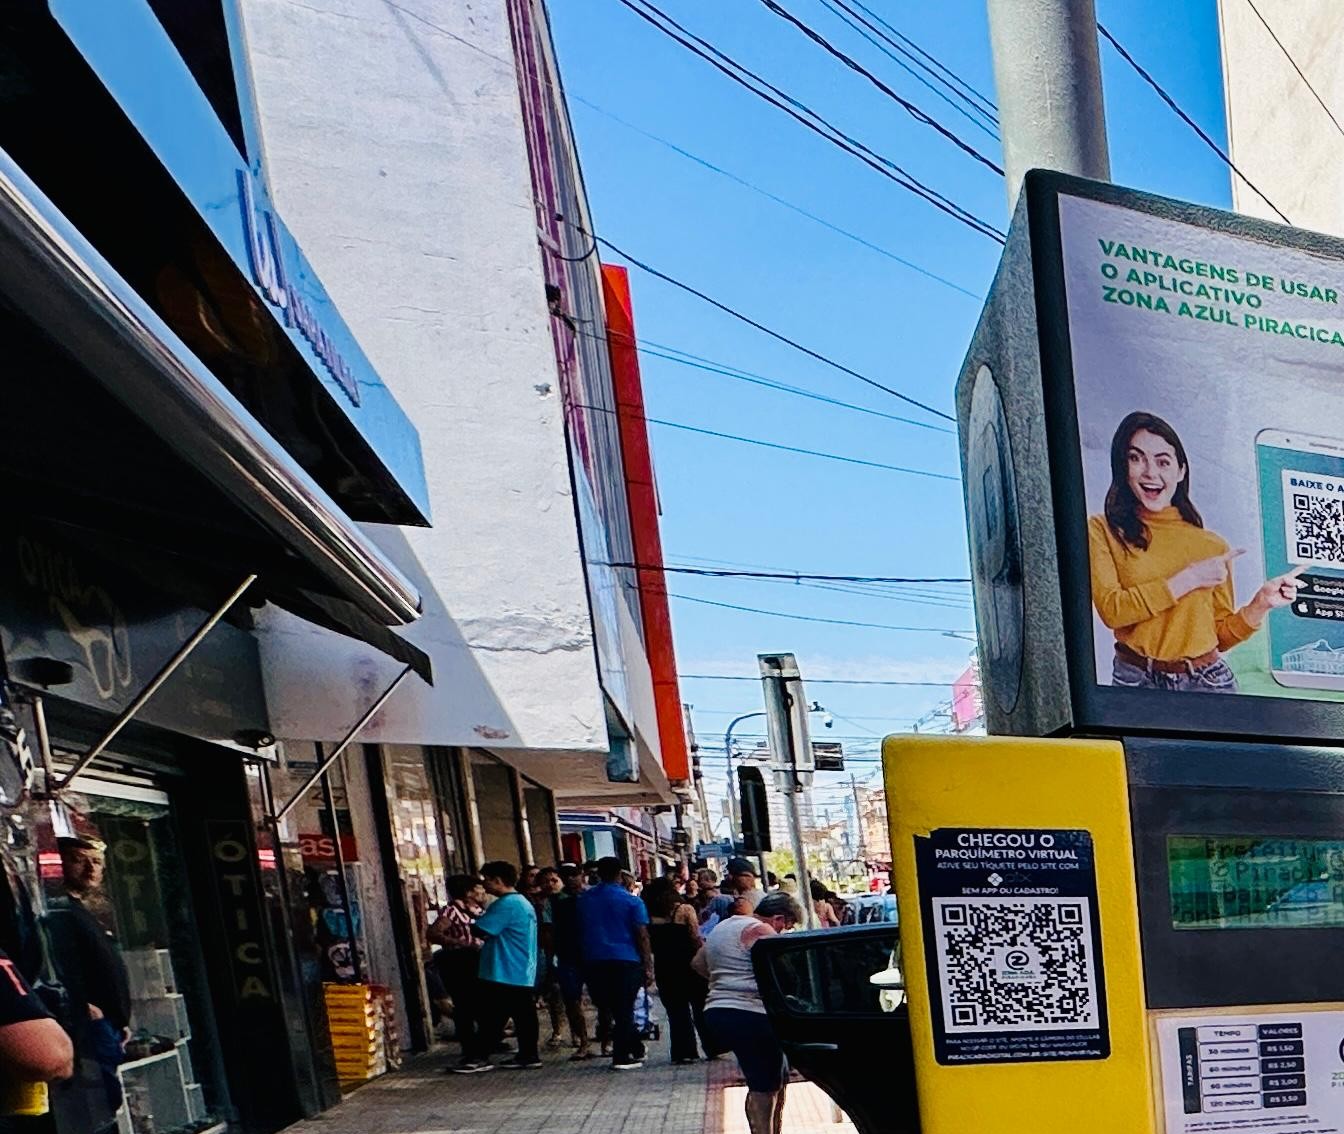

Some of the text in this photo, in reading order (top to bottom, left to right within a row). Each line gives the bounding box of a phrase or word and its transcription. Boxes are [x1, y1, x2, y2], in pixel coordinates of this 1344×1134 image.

[1098, 239, 1338, 304] VANTAGENS DE USAR
[1101, 263, 1262, 309] O APLICATIVO
[1102, 285, 1170, 313] ZONA
[1178, 301, 1238, 326] AZUL
[1290, 478, 1323, 490] BAIXE
[1326, 483, 1334, 492] O
[957, 833, 1055, 848] CHEGOU O
[935, 847, 1078, 860] PARQUÍMETRO VIRTUAL
[1059, 862, 1079, 870] COM
[999, 887, 1012, 895] OU
